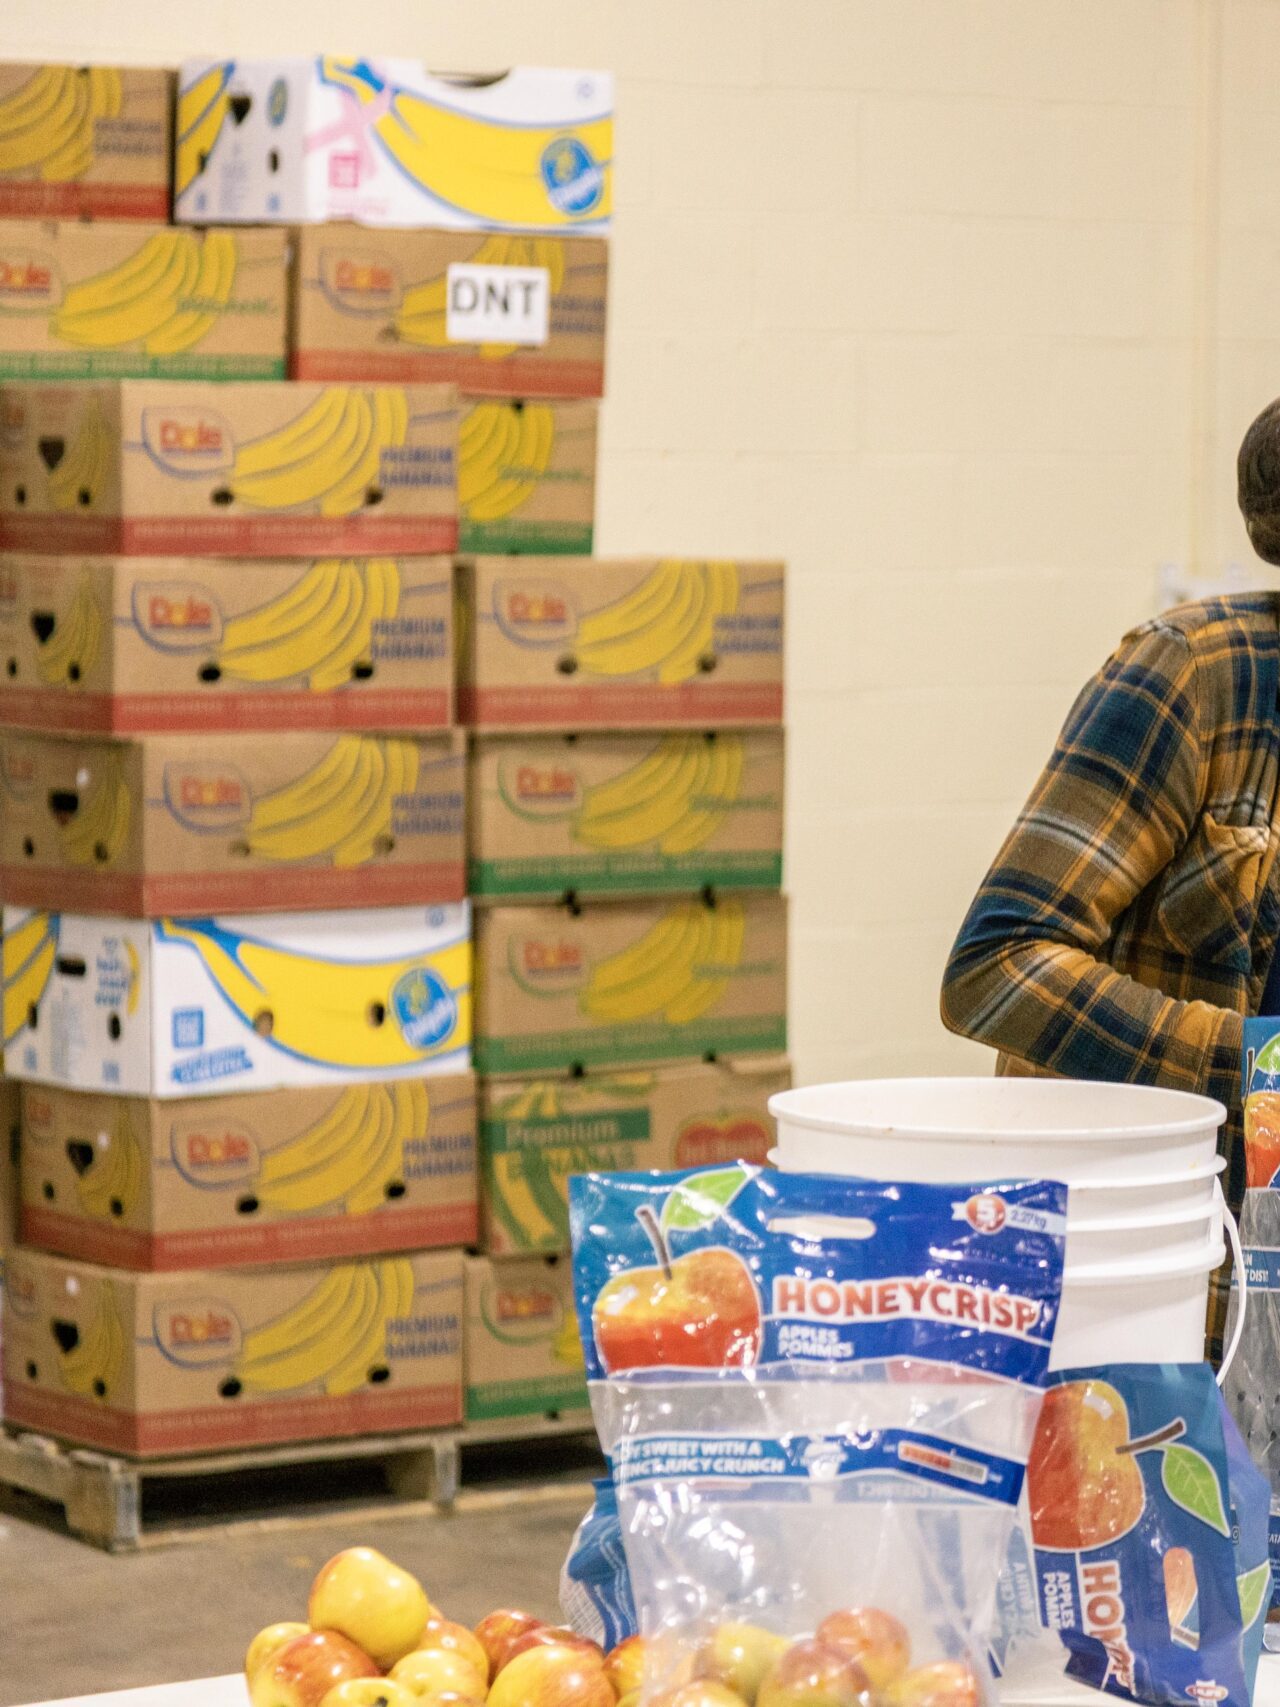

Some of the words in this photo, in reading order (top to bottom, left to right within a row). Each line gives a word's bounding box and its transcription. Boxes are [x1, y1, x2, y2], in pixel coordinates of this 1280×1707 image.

[452, 279, 538, 315] DNT
[159, 419, 222, 450] Dole
[148, 595, 212, 628] Dole
[187, 1134, 250, 1165] Dole
[776, 1279, 1038, 1332] HONEYCRISP
[170, 1312, 232, 1342] Dole
[779, 1325, 839, 1344] APPLES
[778, 1340, 855, 1359] POMMES
[643, 1440, 698, 1458] SWEET
[700, 1440, 748, 1457] WITH
[713, 1457, 787, 1473] CRUNCH
[1056, 1570, 1076, 1629] APPLES
